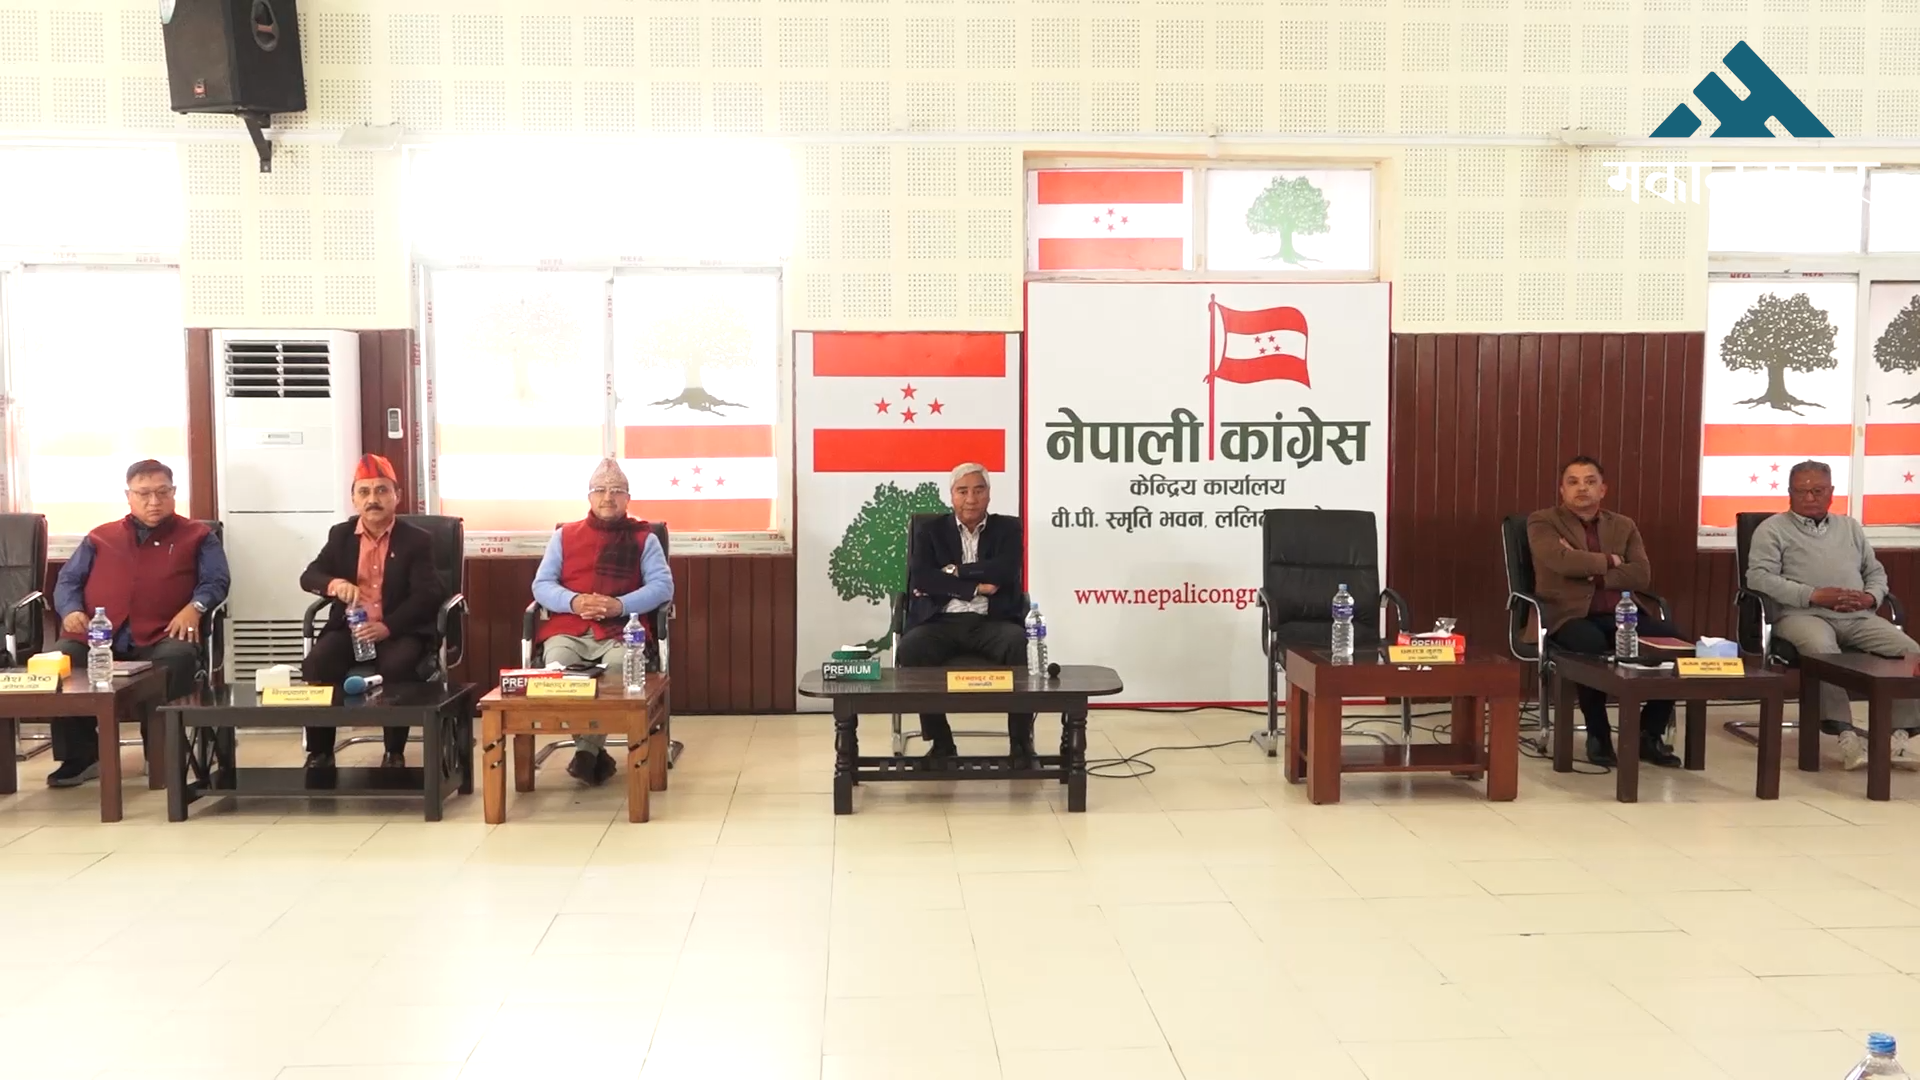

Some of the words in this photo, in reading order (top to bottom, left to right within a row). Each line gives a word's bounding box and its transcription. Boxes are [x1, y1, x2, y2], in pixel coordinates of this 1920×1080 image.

[1046, 407, 1204, 465] नेपाली
[1221, 406, 1371, 468] कांग्रेस
[1130, 474, 1197, 498] केन्द्रिय
[1204, 474, 1286, 496] कार्यालय
[1106, 506, 1152, 533] स्मृति
[1075, 584, 1257, 610] www.nepalicongr
[824, 665, 871, 675] PREMIUM
